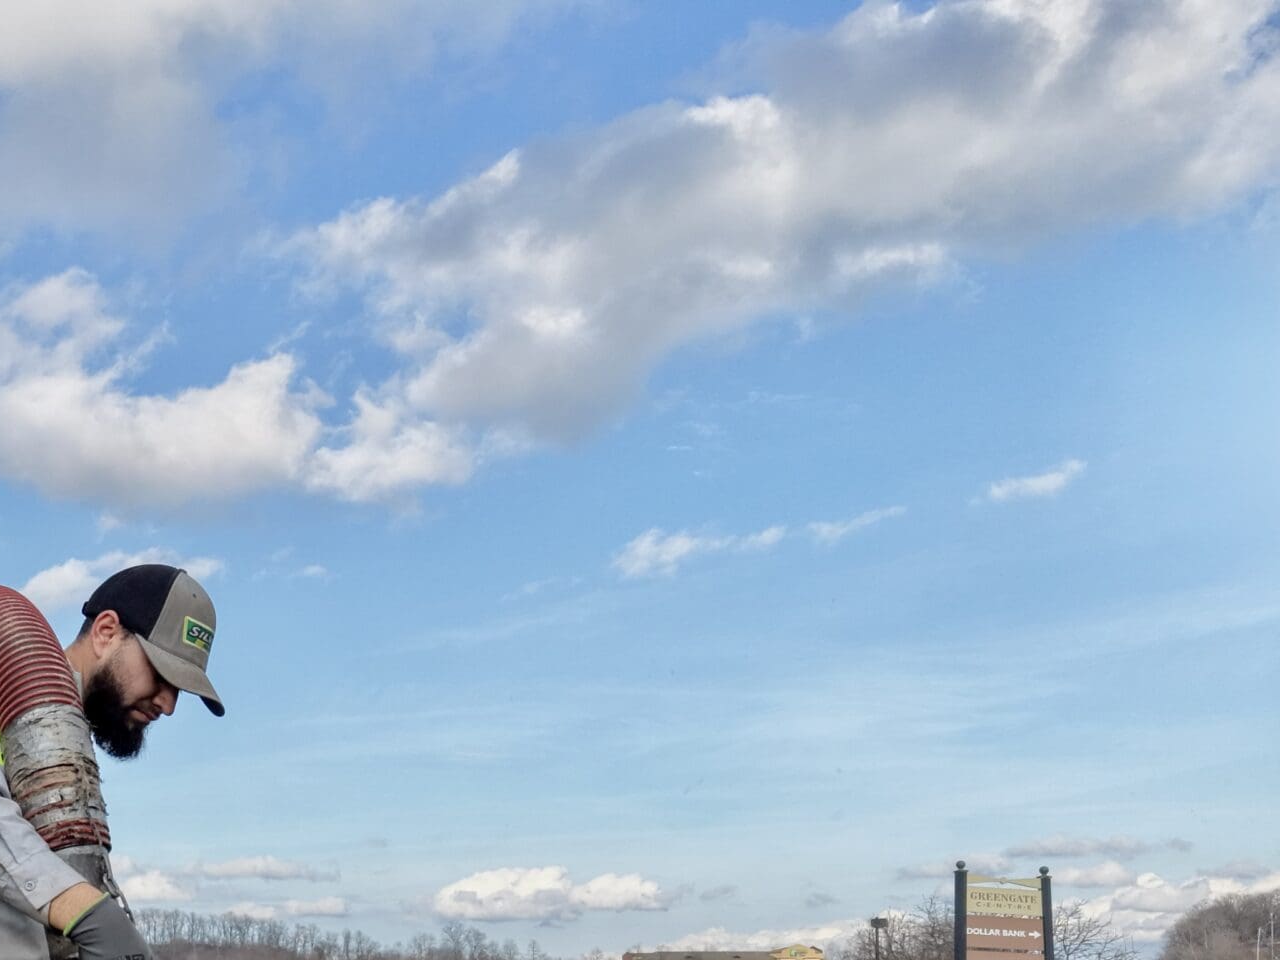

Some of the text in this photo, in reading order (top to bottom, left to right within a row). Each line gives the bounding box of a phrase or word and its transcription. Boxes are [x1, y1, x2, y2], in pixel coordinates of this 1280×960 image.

[970, 891, 1037, 904] GREENGATE
[966, 927, 1026, 938] DOLLAR BANK
